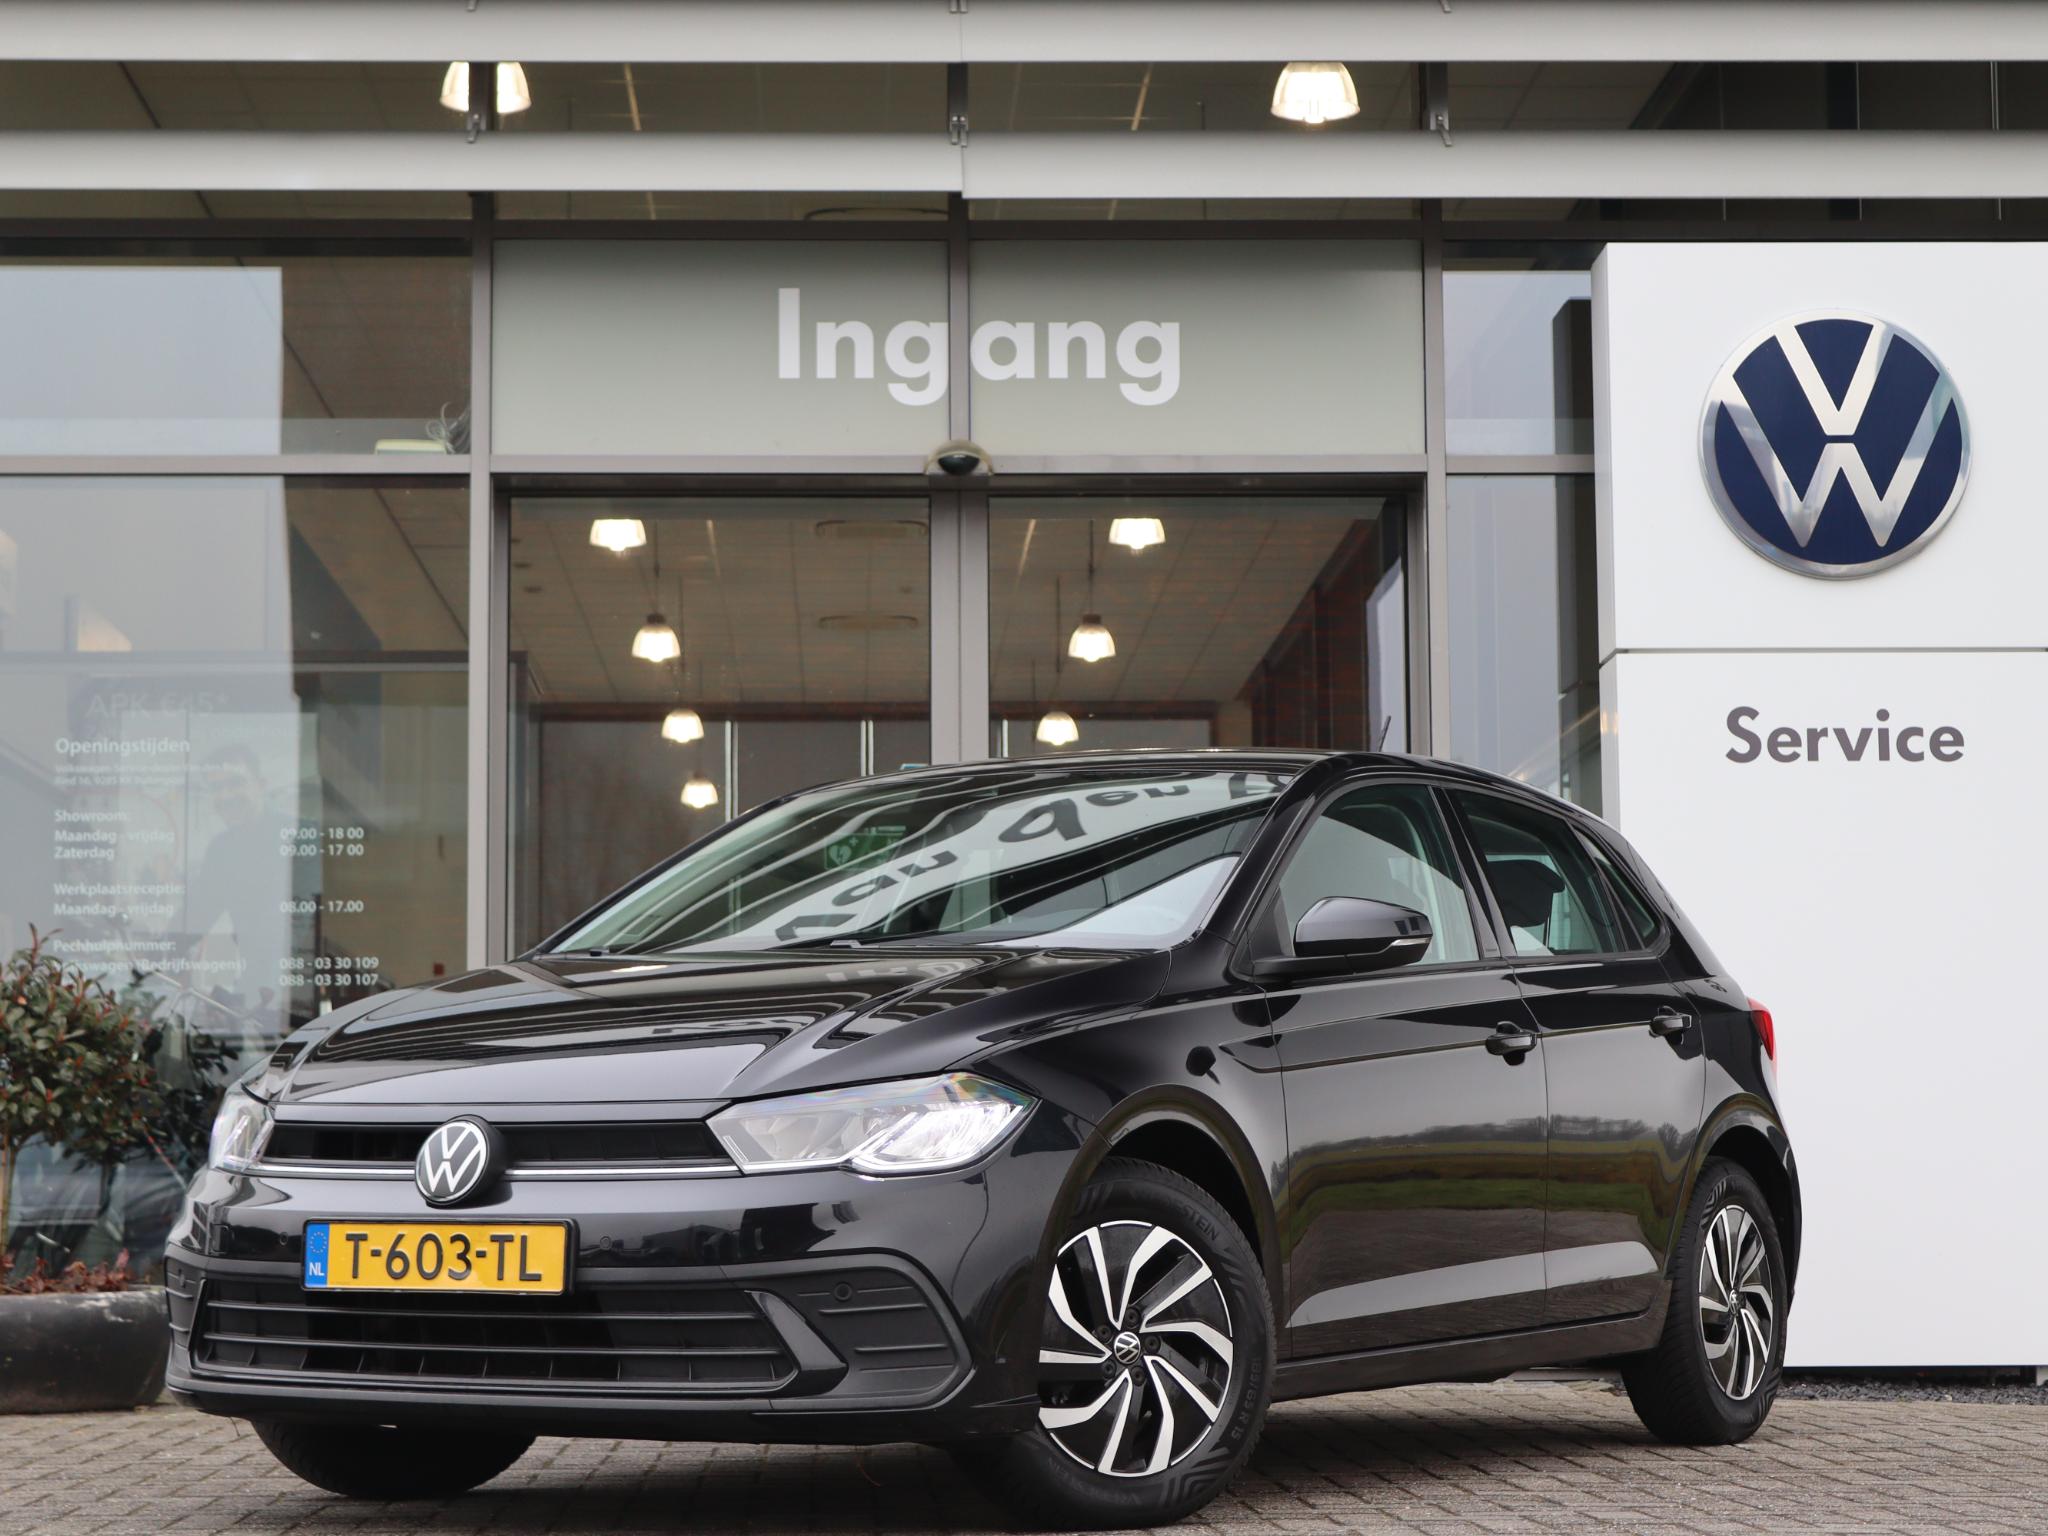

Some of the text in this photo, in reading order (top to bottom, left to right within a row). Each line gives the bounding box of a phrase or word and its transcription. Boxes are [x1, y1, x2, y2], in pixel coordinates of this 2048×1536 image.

[777, 287, 1181, 406] Ingang
[1725, 705, 1965, 764] Service
[55, 737, 191, 757] Openingstijden
[54, 830, 117, 844] Maandag
[127, 830, 175, 844] vrijdag
[54, 847, 115, 861] Zaterdag
[54, 903, 117, 917] Maandag
[127, 903, 175, 917] vrijdag
[327, 900, 365, 913] 17.00
[314, 957, 332, 969] 03
[334, 957, 352, 969] 30
[355, 957, 380, 969] 109
[314, 973, 332, 986] 03
[334, 973, 352, 986] 30
[355, 973, 379, 986] 107
[345, 1232, 542, 1282] T-603-TL
[309, 1262, 325, 1276] NL
